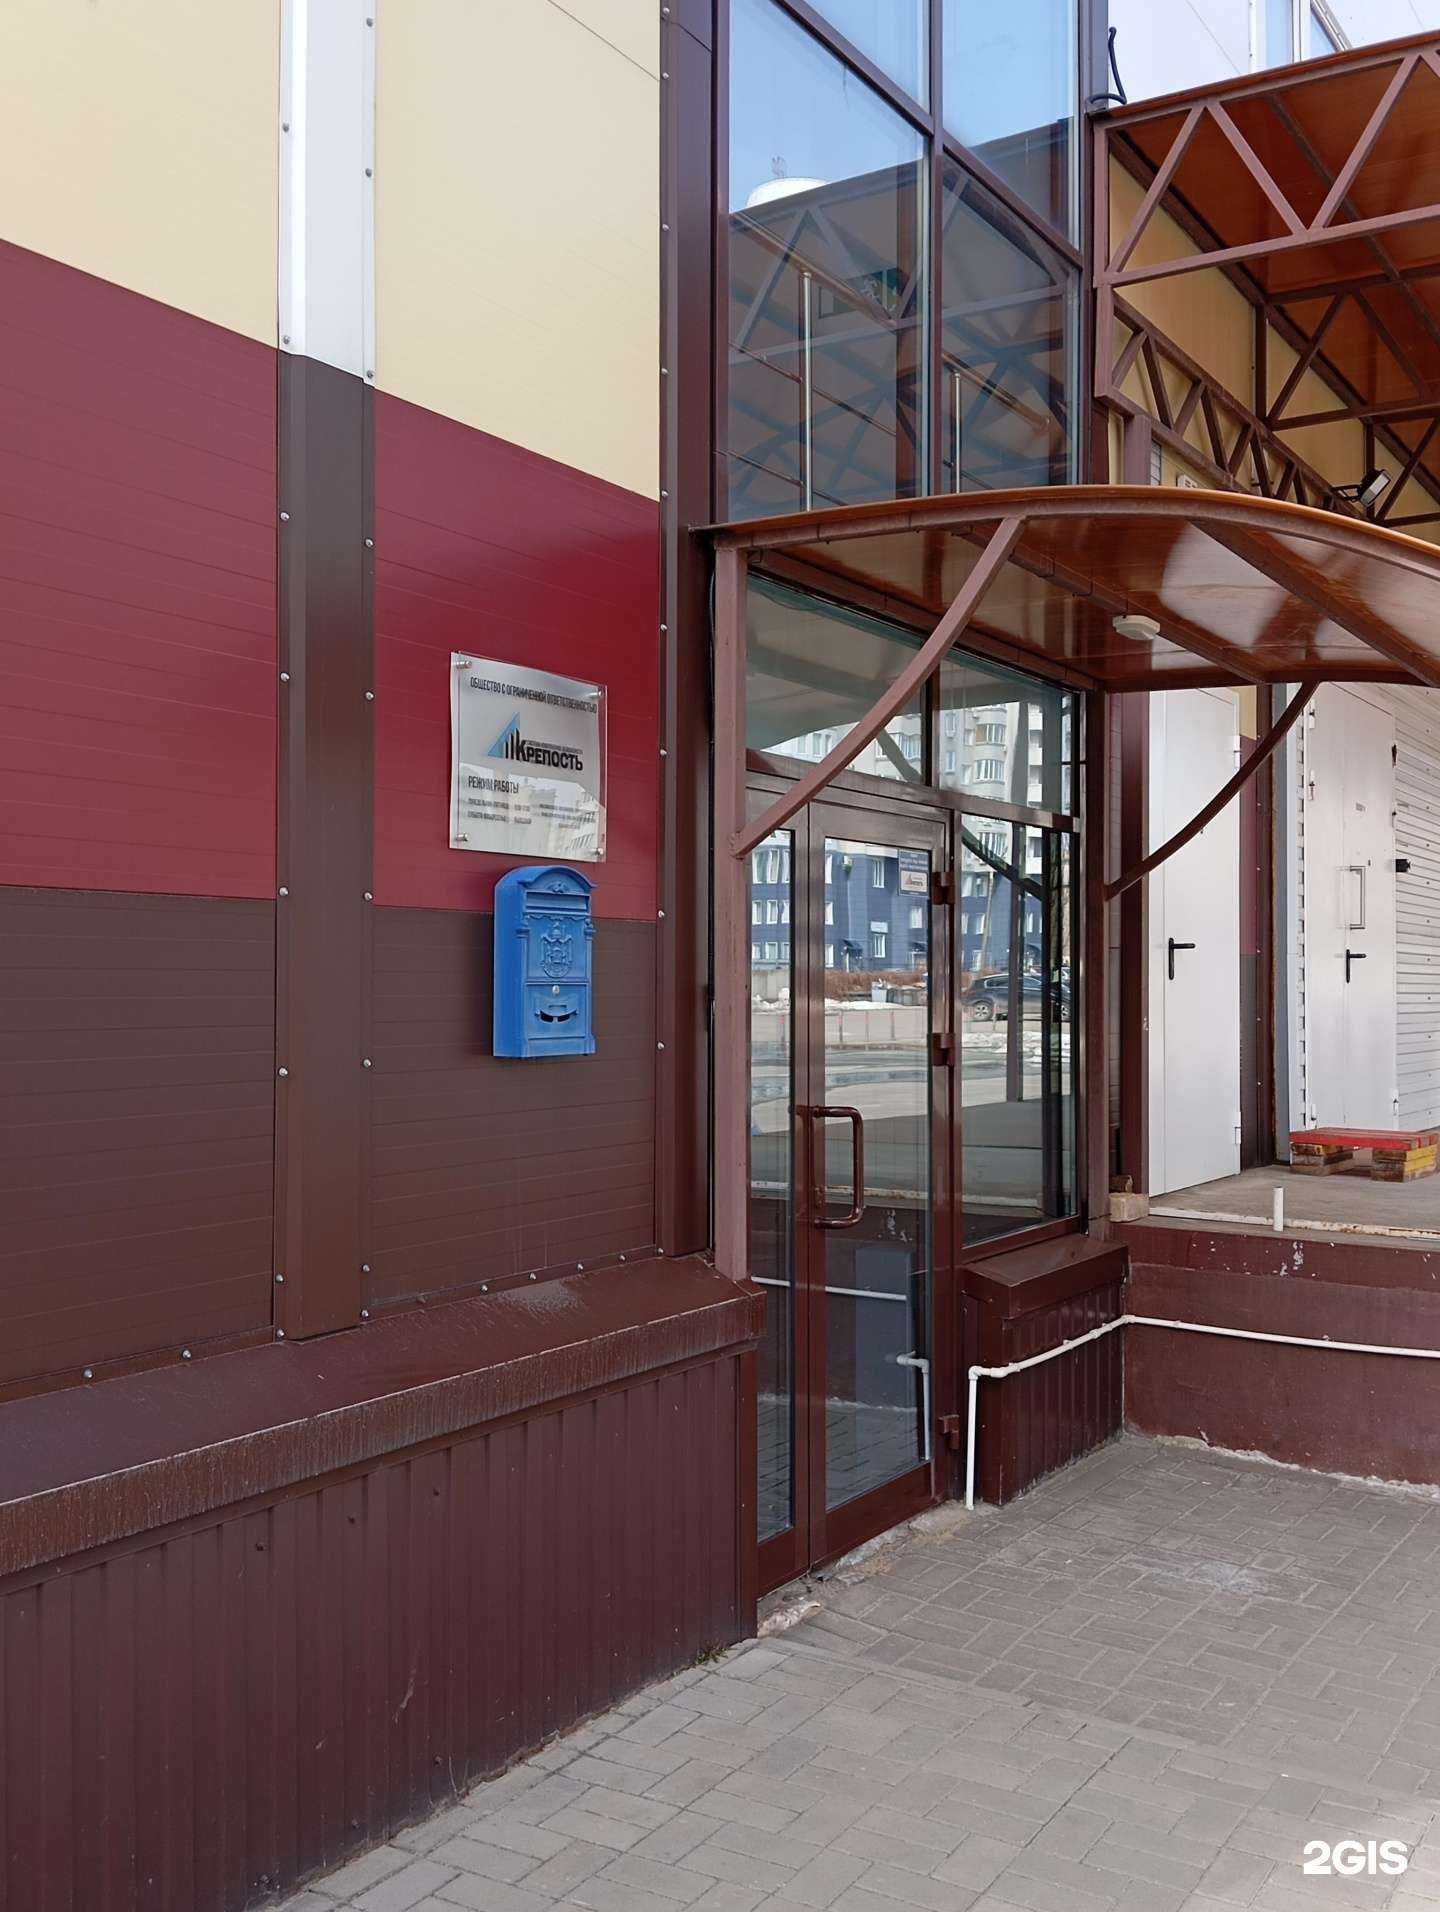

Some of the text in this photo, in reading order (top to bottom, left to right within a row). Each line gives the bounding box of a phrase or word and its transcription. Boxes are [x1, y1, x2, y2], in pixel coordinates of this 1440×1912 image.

[470, 676, 501, 693] ОБЩЕСТВО
[501, 683, 506, 694] С
[468, 775, 519, 793] РЕЖИМ РАБОТЫ
